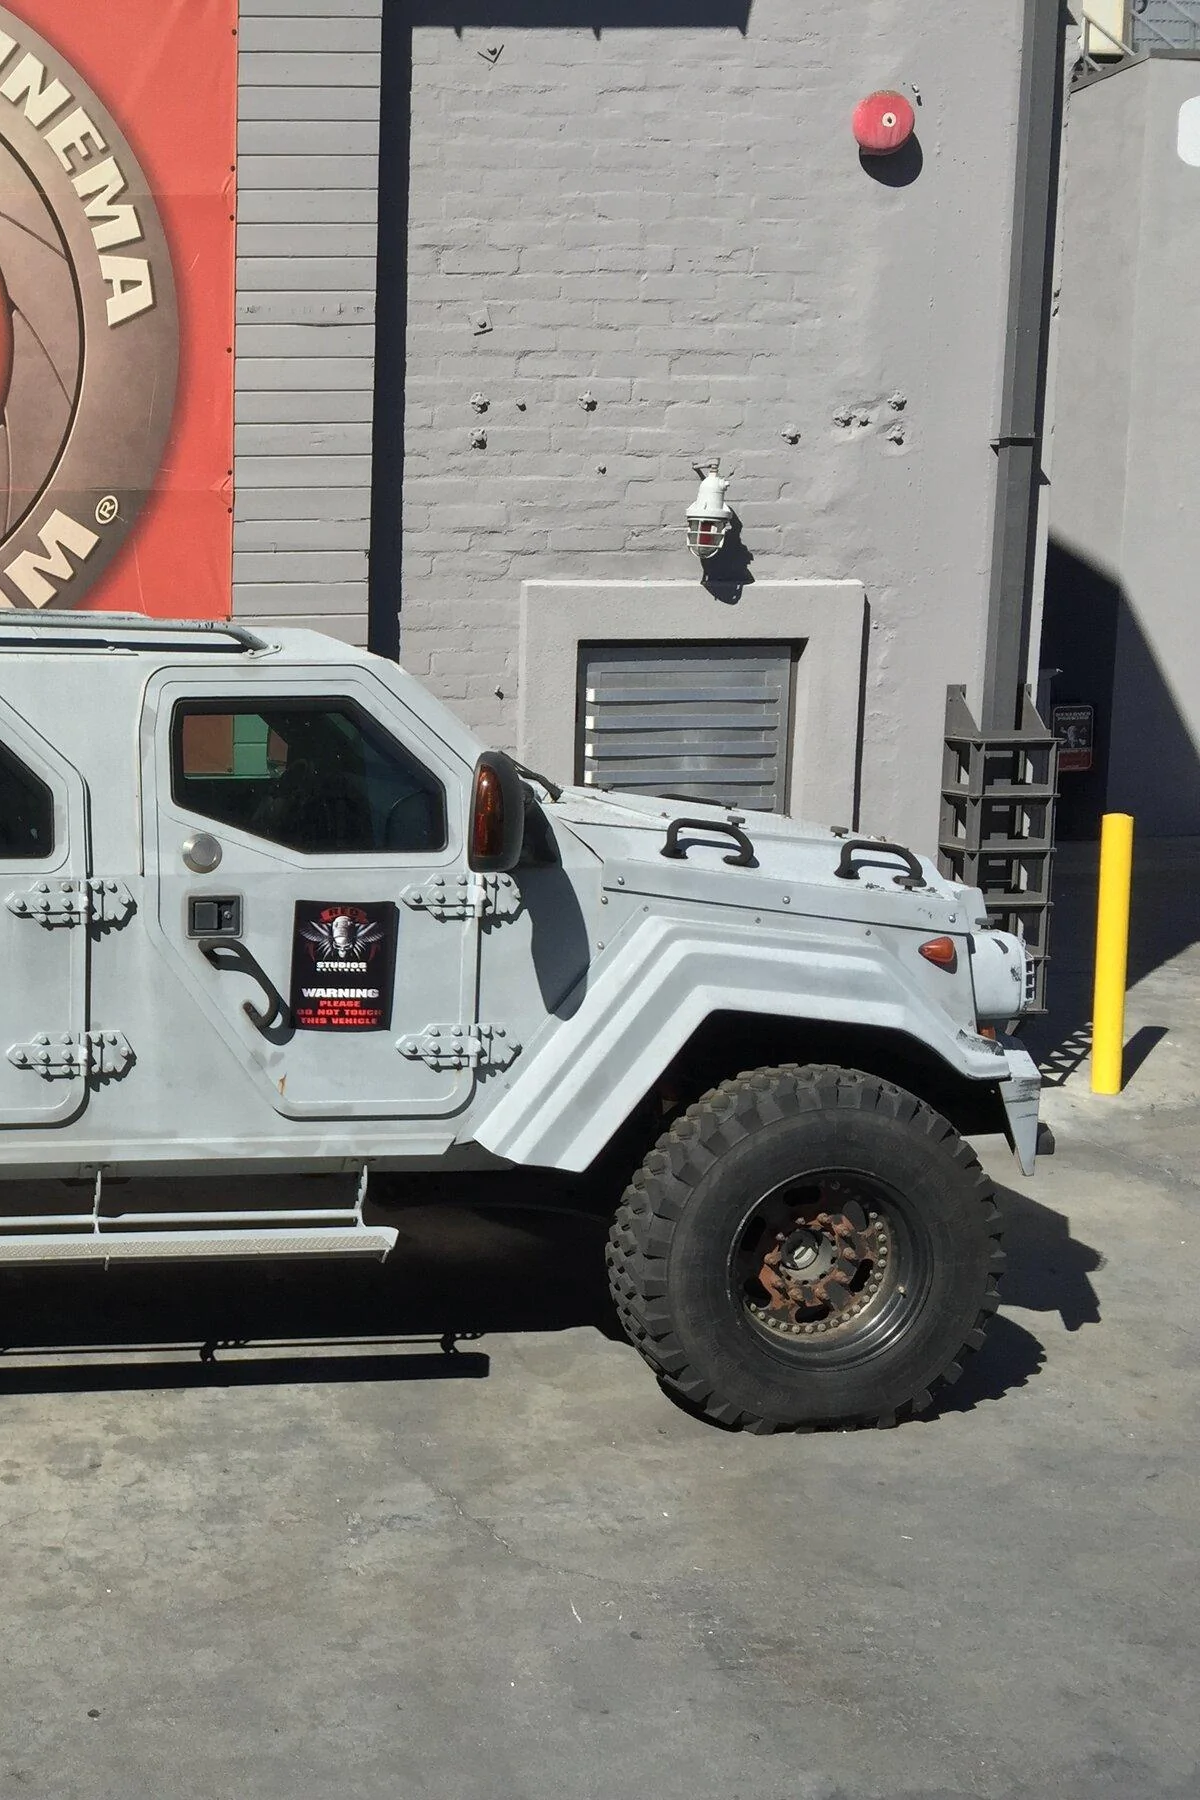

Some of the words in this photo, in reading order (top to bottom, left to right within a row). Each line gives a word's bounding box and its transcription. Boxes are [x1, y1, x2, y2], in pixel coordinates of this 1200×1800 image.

[316, 961, 367, 969] STUDIOS
[301, 987, 380, 998] WARNING
[296, 1008, 313, 1016] DO
[317, 1008, 340, 1016] NOT
[344, 1008, 385, 1016] TOUCH
